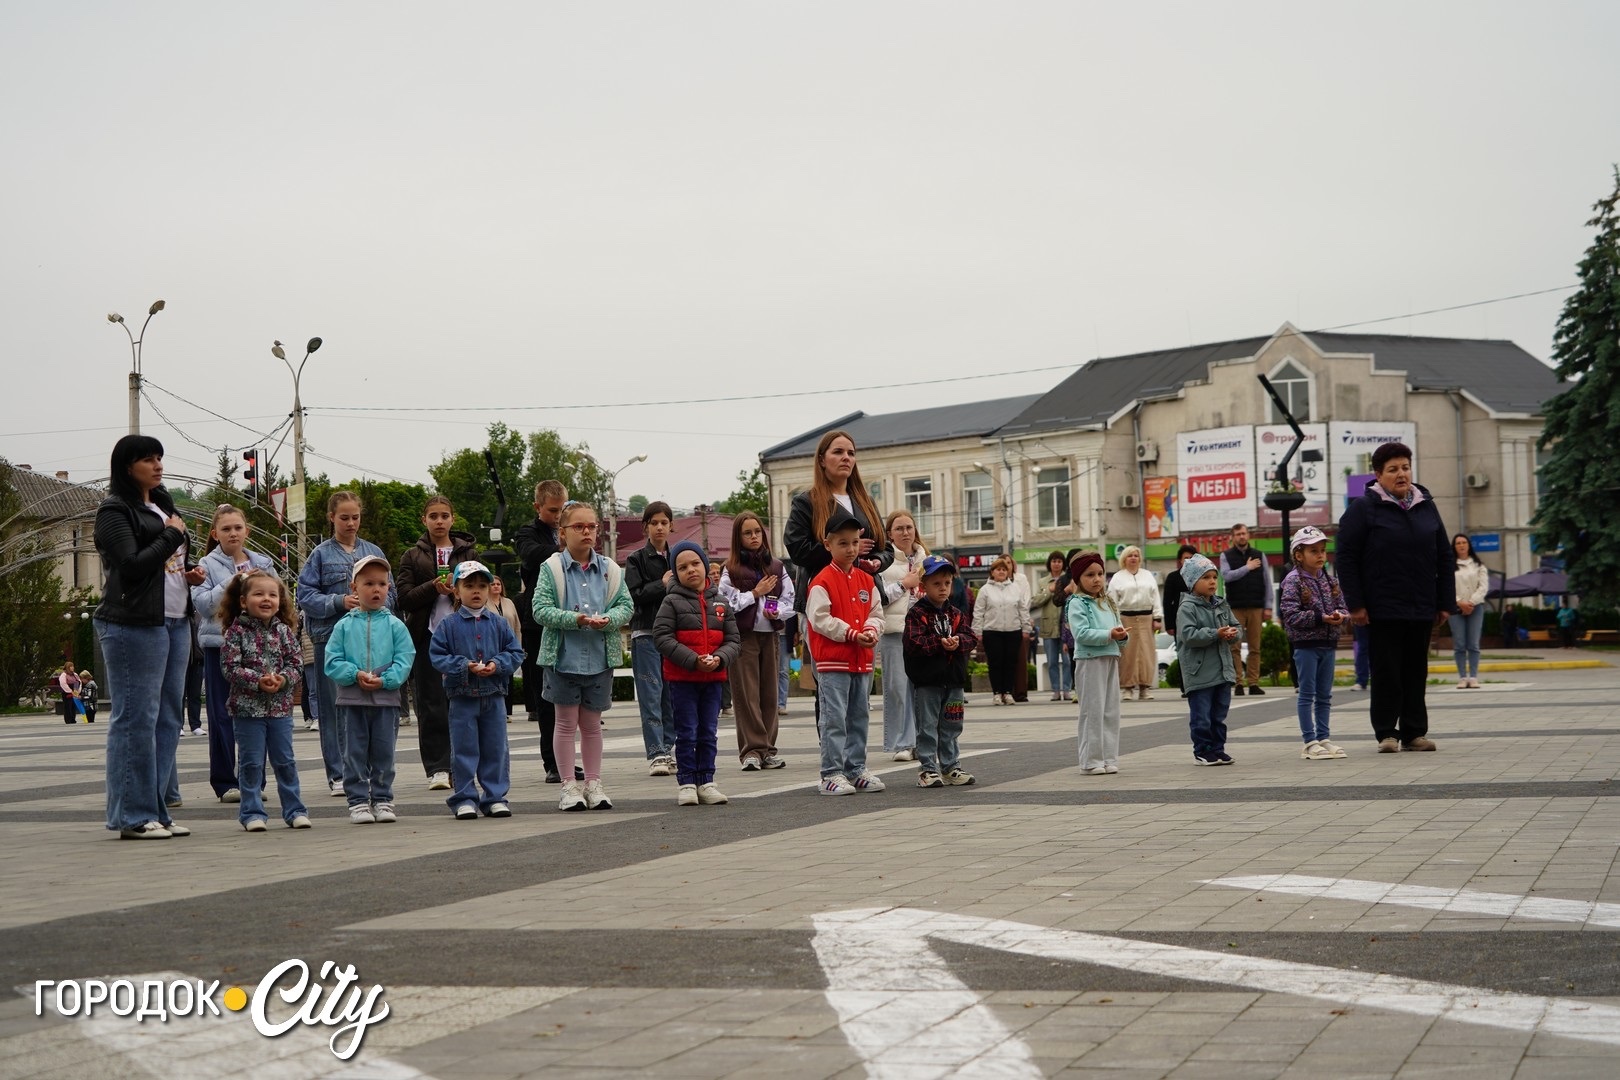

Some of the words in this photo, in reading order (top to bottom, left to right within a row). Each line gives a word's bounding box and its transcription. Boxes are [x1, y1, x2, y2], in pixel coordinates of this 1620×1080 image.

[1199, 440, 1242, 452] КОНТИНЕНТ
[1356, 436, 1402, 444] КОНТИНЕНТ
[1192, 478, 1241, 498] МЕБЛІ
[1179, 535, 1232, 553] АПТЕК
